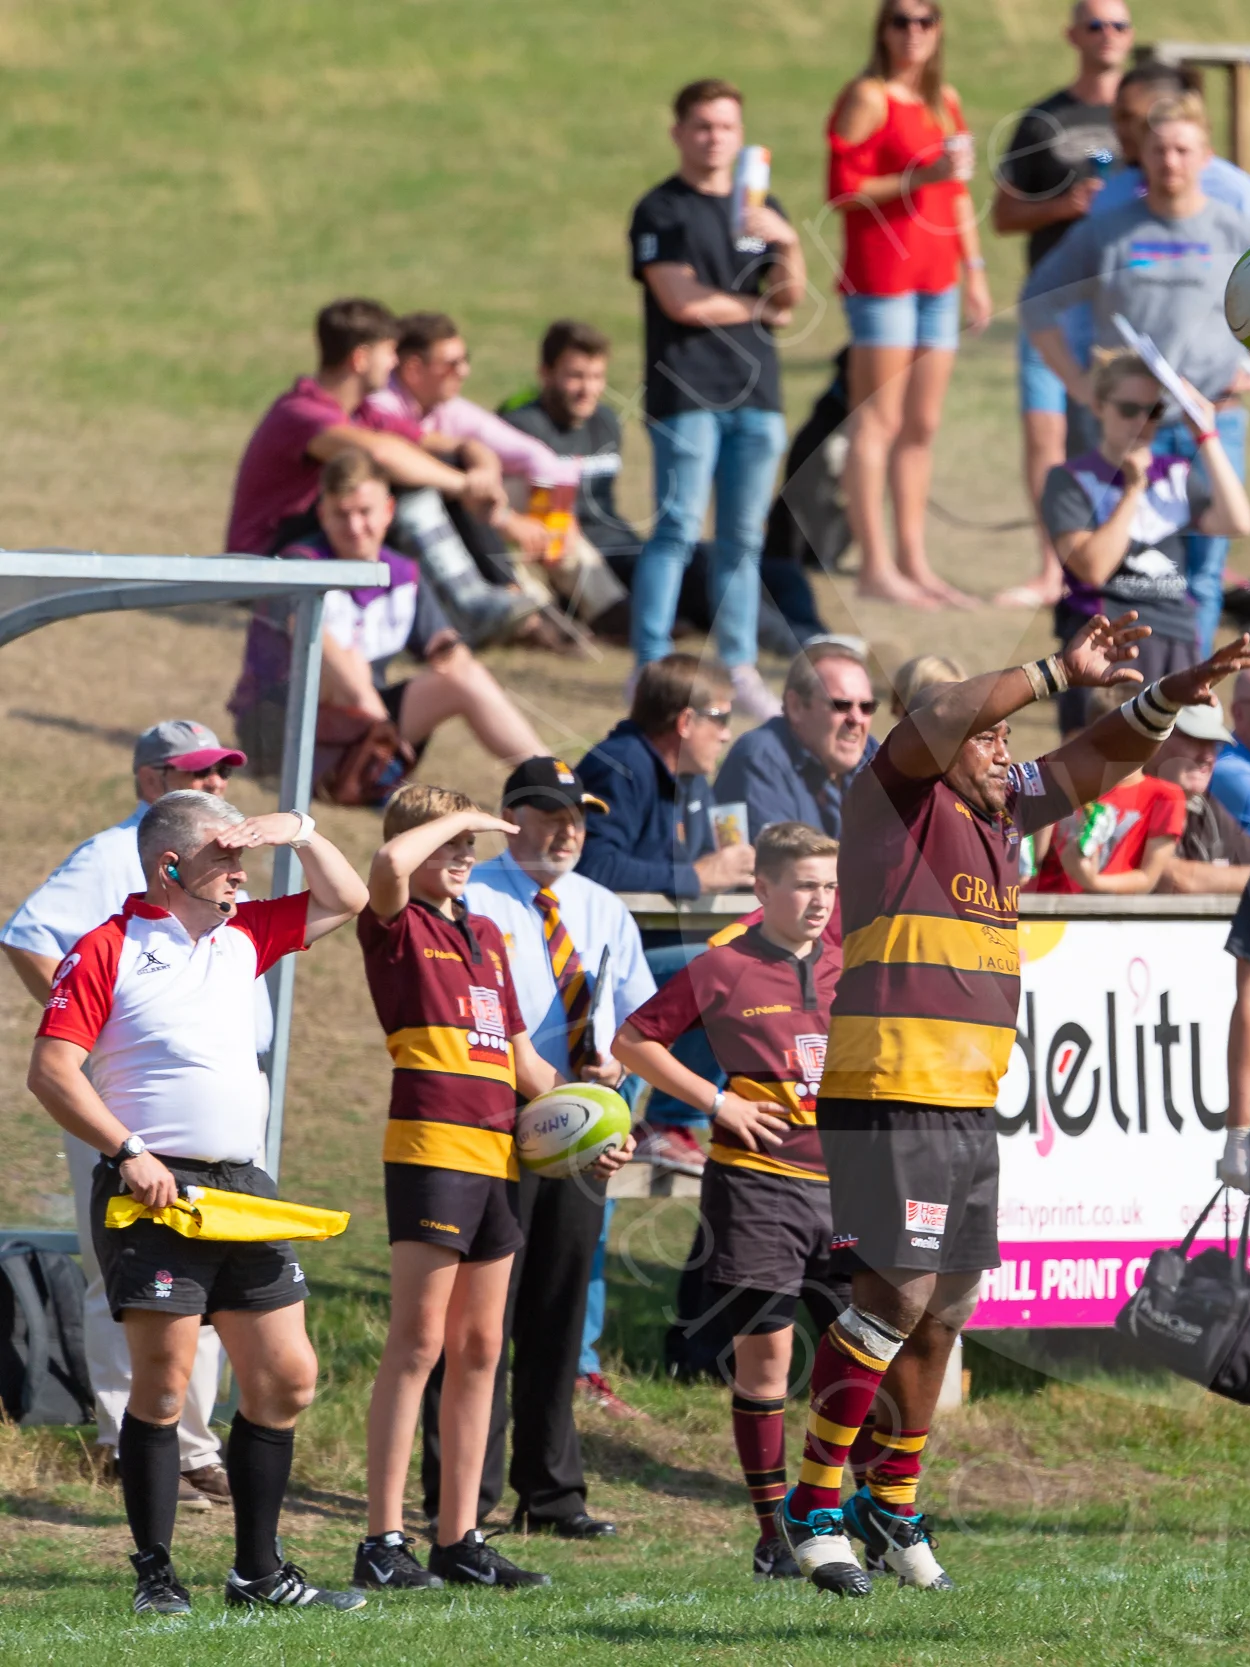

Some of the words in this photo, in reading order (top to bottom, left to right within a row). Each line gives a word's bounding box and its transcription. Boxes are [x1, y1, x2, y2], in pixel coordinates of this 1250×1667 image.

[136, 963, 172, 976] GILBERT
[921, 1203, 949, 1217] Haine
[1041, 1257, 1123, 1301] PRINT
